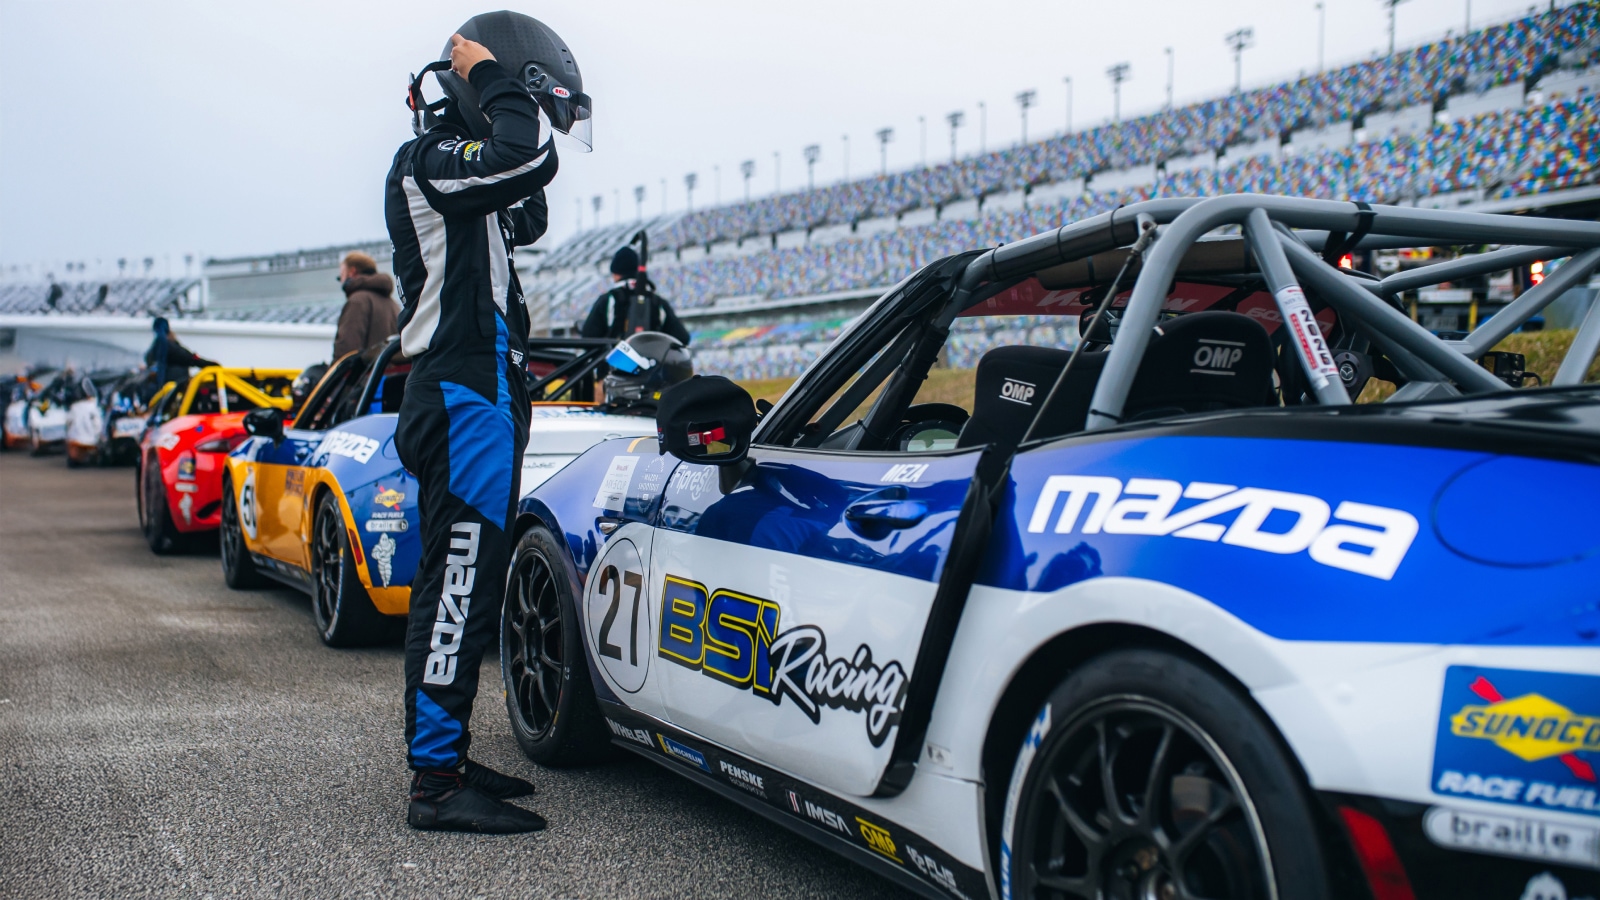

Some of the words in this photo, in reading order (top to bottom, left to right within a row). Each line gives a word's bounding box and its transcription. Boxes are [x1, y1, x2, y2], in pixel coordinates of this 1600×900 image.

[555, 88, 568, 96] BELL
[1193, 345, 1243, 369] OMP
[1001, 381, 1035, 402] OMP
[880, 463, 930, 482] MEZA
[371, 521, 393, 529] braille
[372, 511, 387, 519] RACE
[1027, 475, 1419, 581] mazda
[423, 522, 481, 686] mazda
[598, 564, 643, 668] 27
[767, 625, 907, 748] Racing
[605, 716, 655, 748] WHELEN
[1460, 711, 1600, 747] SUNOCO
[672, 746, 704, 766] MICHELIN
[719, 760, 765, 790] PENSKE
[1437, 770, 1524, 802] RACE
[1525, 782, 1600, 811] FUEL
[804, 800, 853, 837] IMSA
[1452, 815, 1572, 847] braille
[859, 824, 898, 856] OMP
